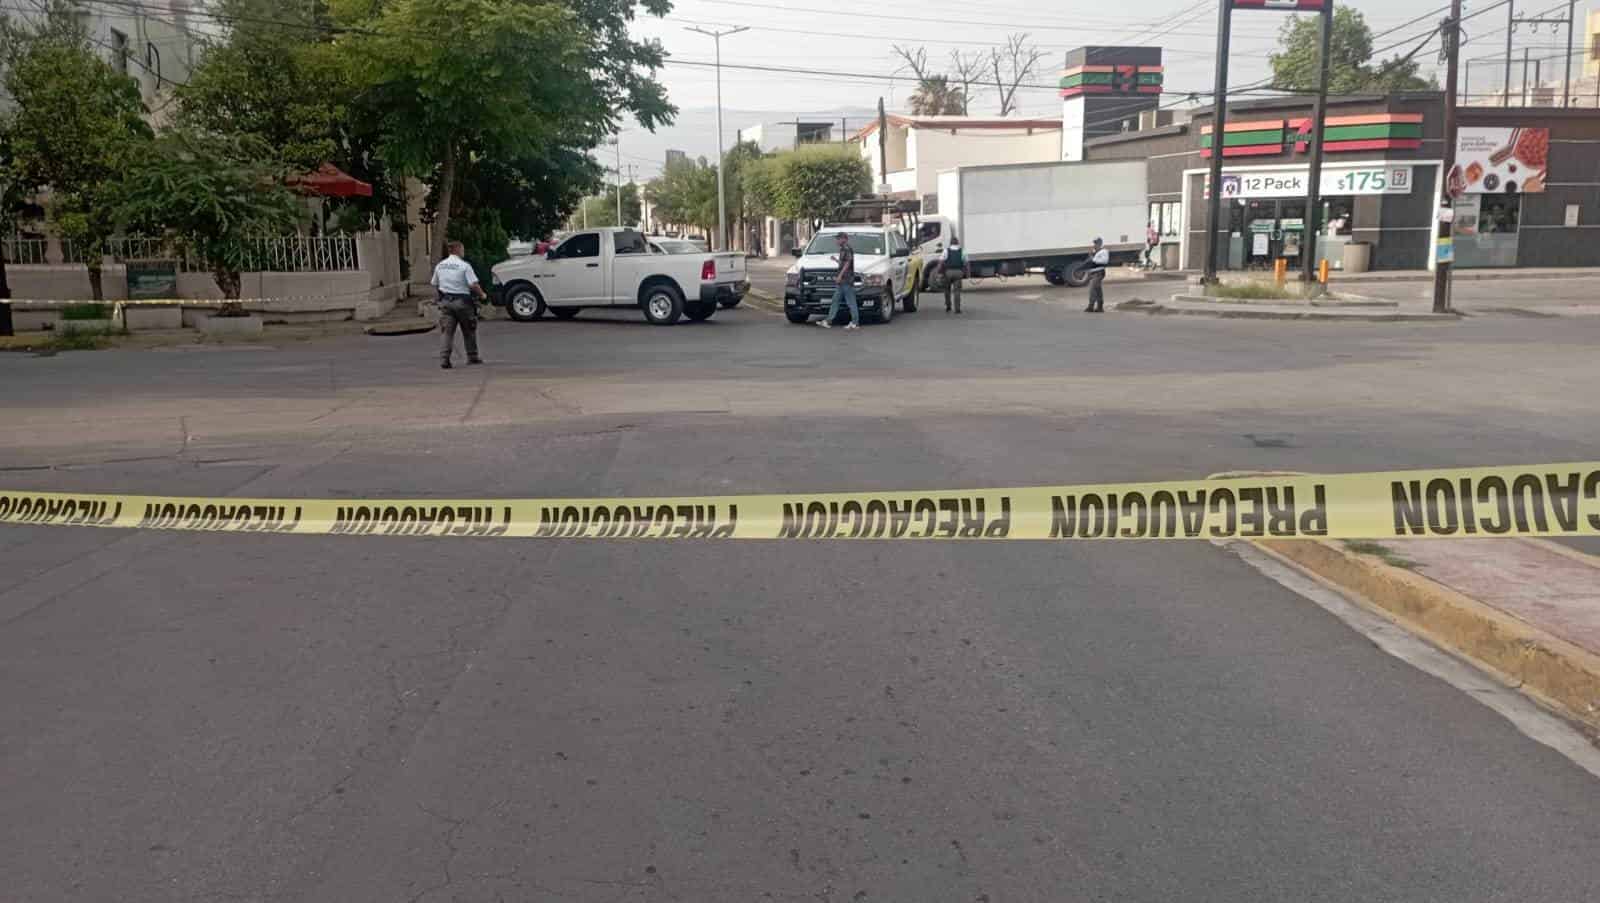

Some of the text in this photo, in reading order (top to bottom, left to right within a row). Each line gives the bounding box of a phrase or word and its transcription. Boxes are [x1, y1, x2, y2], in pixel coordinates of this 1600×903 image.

[1245, 176, 1302, 191] 12 Pack
[1337, 171, 1387, 191] $175
[138, 503, 302, 531] PRECAUCION
[330, 506, 512, 536] PRECAUCION
[533, 504, 738, 538] PRECAUCION
[779, 496, 1011, 538] PRECAUCION
[1051, 484, 1327, 538] PRECAUCION
